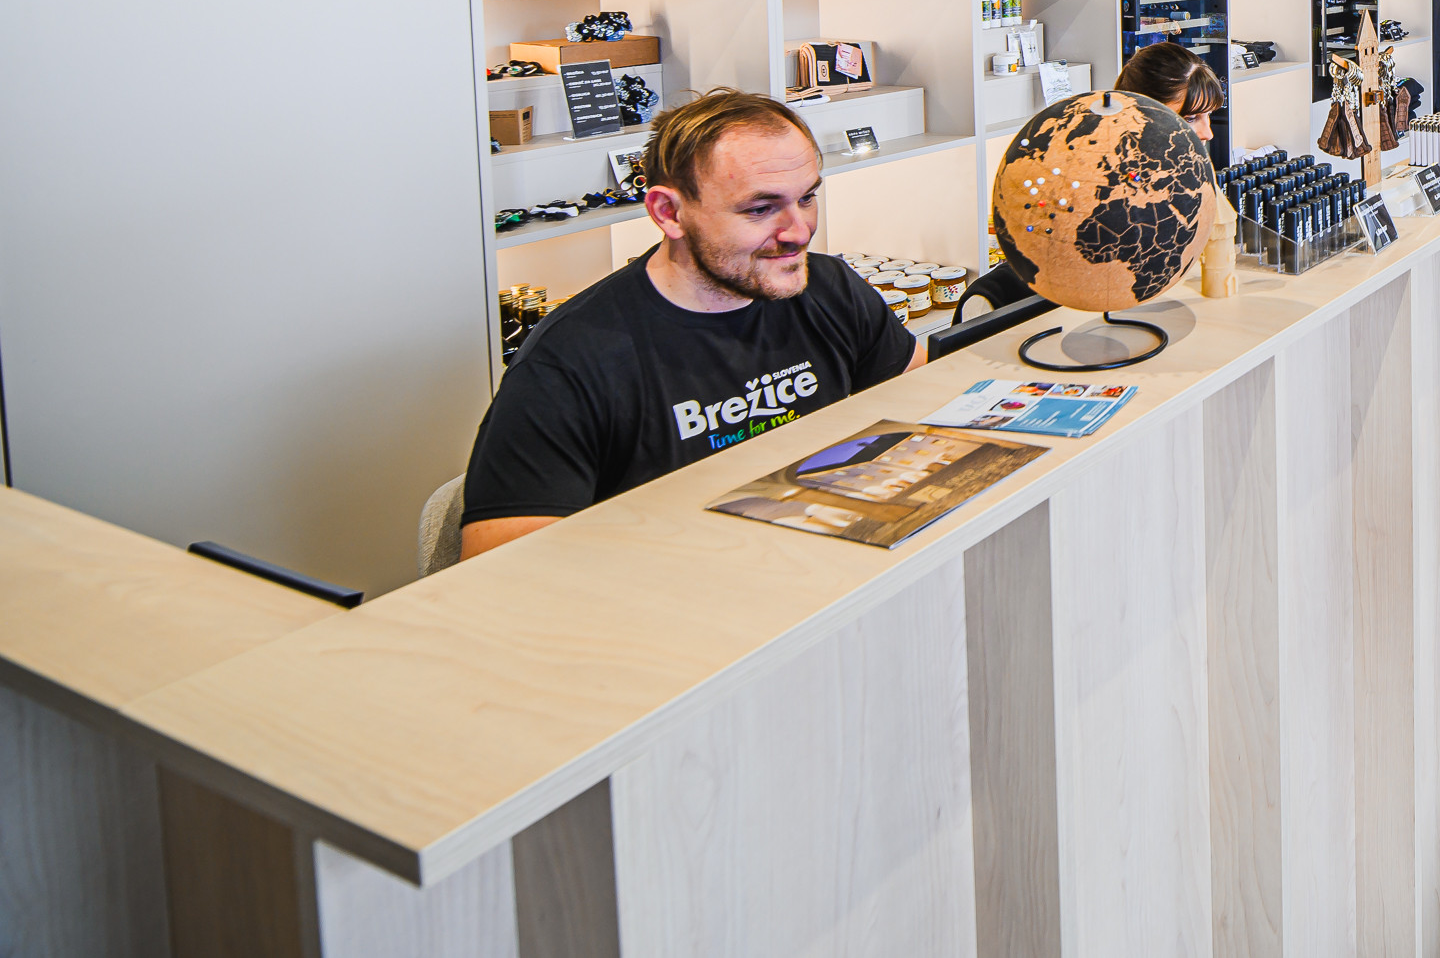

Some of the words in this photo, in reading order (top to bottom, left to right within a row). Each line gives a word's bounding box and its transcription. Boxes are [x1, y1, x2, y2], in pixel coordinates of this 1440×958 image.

[772, 360, 812, 381] SLOVENIA
[672, 370, 819, 441] Brežice
[707, 428, 746, 450] Time
[749, 419, 767, 438] for
[770, 409, 801, 428] me.
